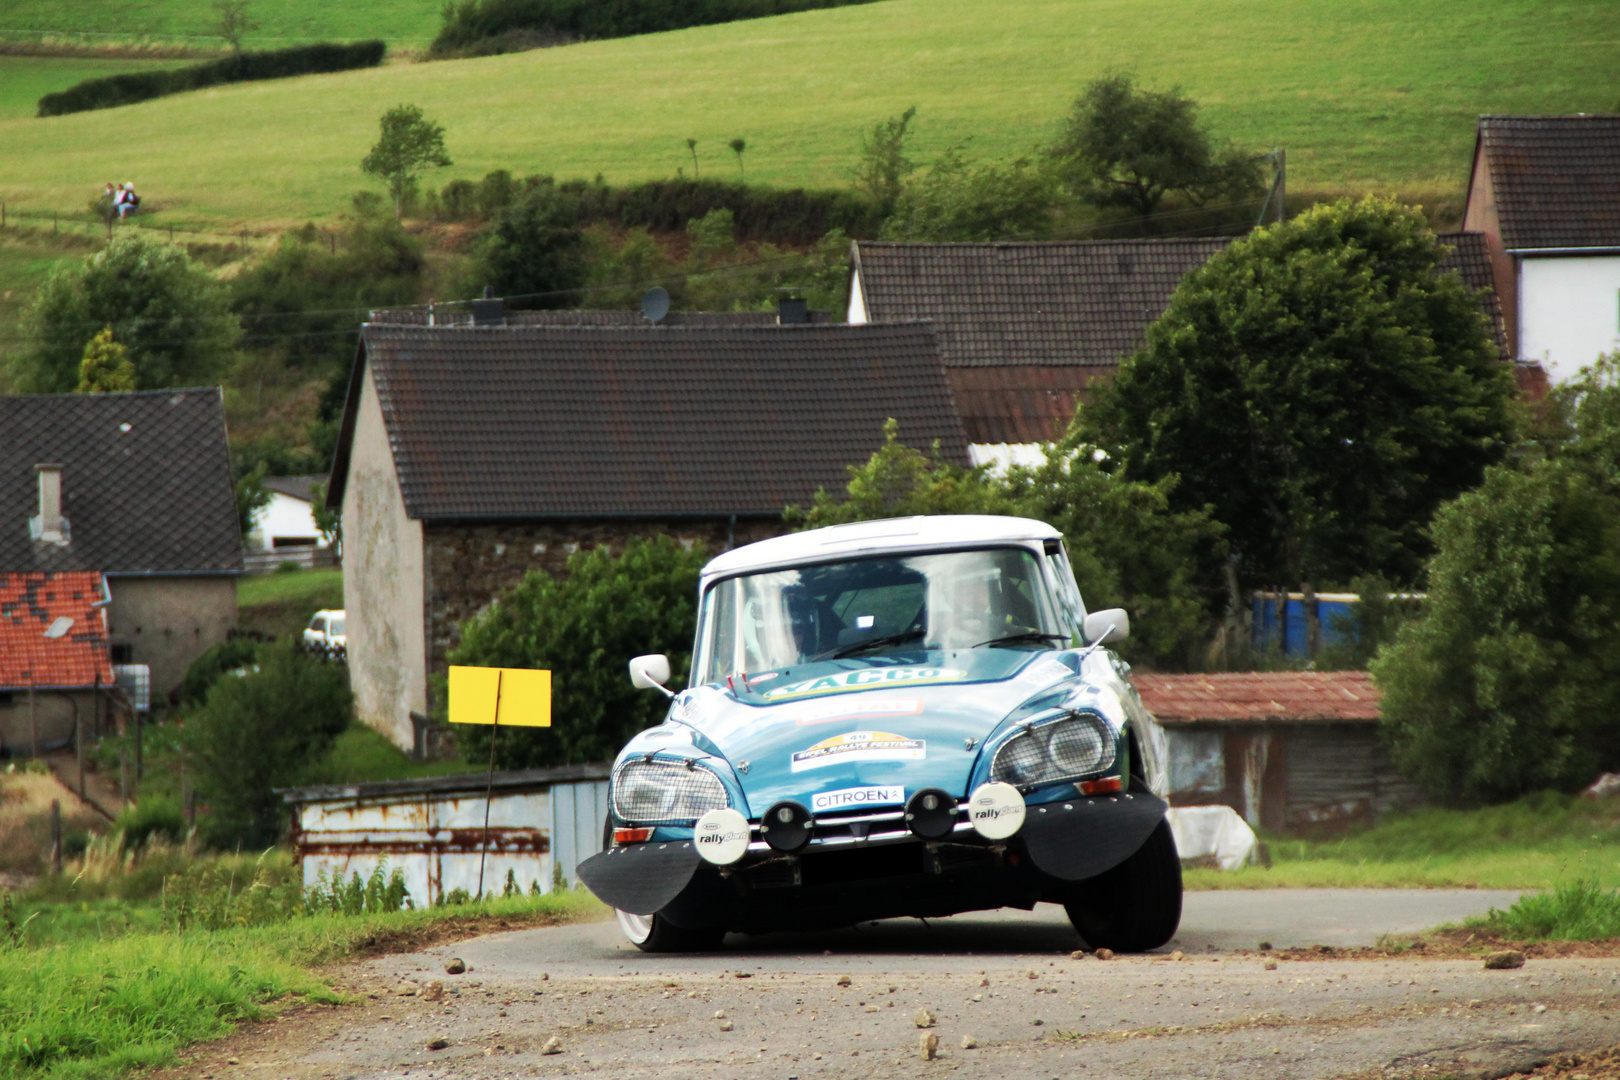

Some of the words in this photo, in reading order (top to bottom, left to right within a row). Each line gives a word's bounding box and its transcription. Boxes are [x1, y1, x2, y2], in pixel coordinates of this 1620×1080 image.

[782, 668, 942, 692] YACCO
[811, 702, 914, 718] TAL
[798, 749, 827, 759] EIFEL
[829, 742, 869, 753] RALLYE
[870, 740, 919, 748] FESTIVAL
[816, 787, 889, 808] CITROËN
